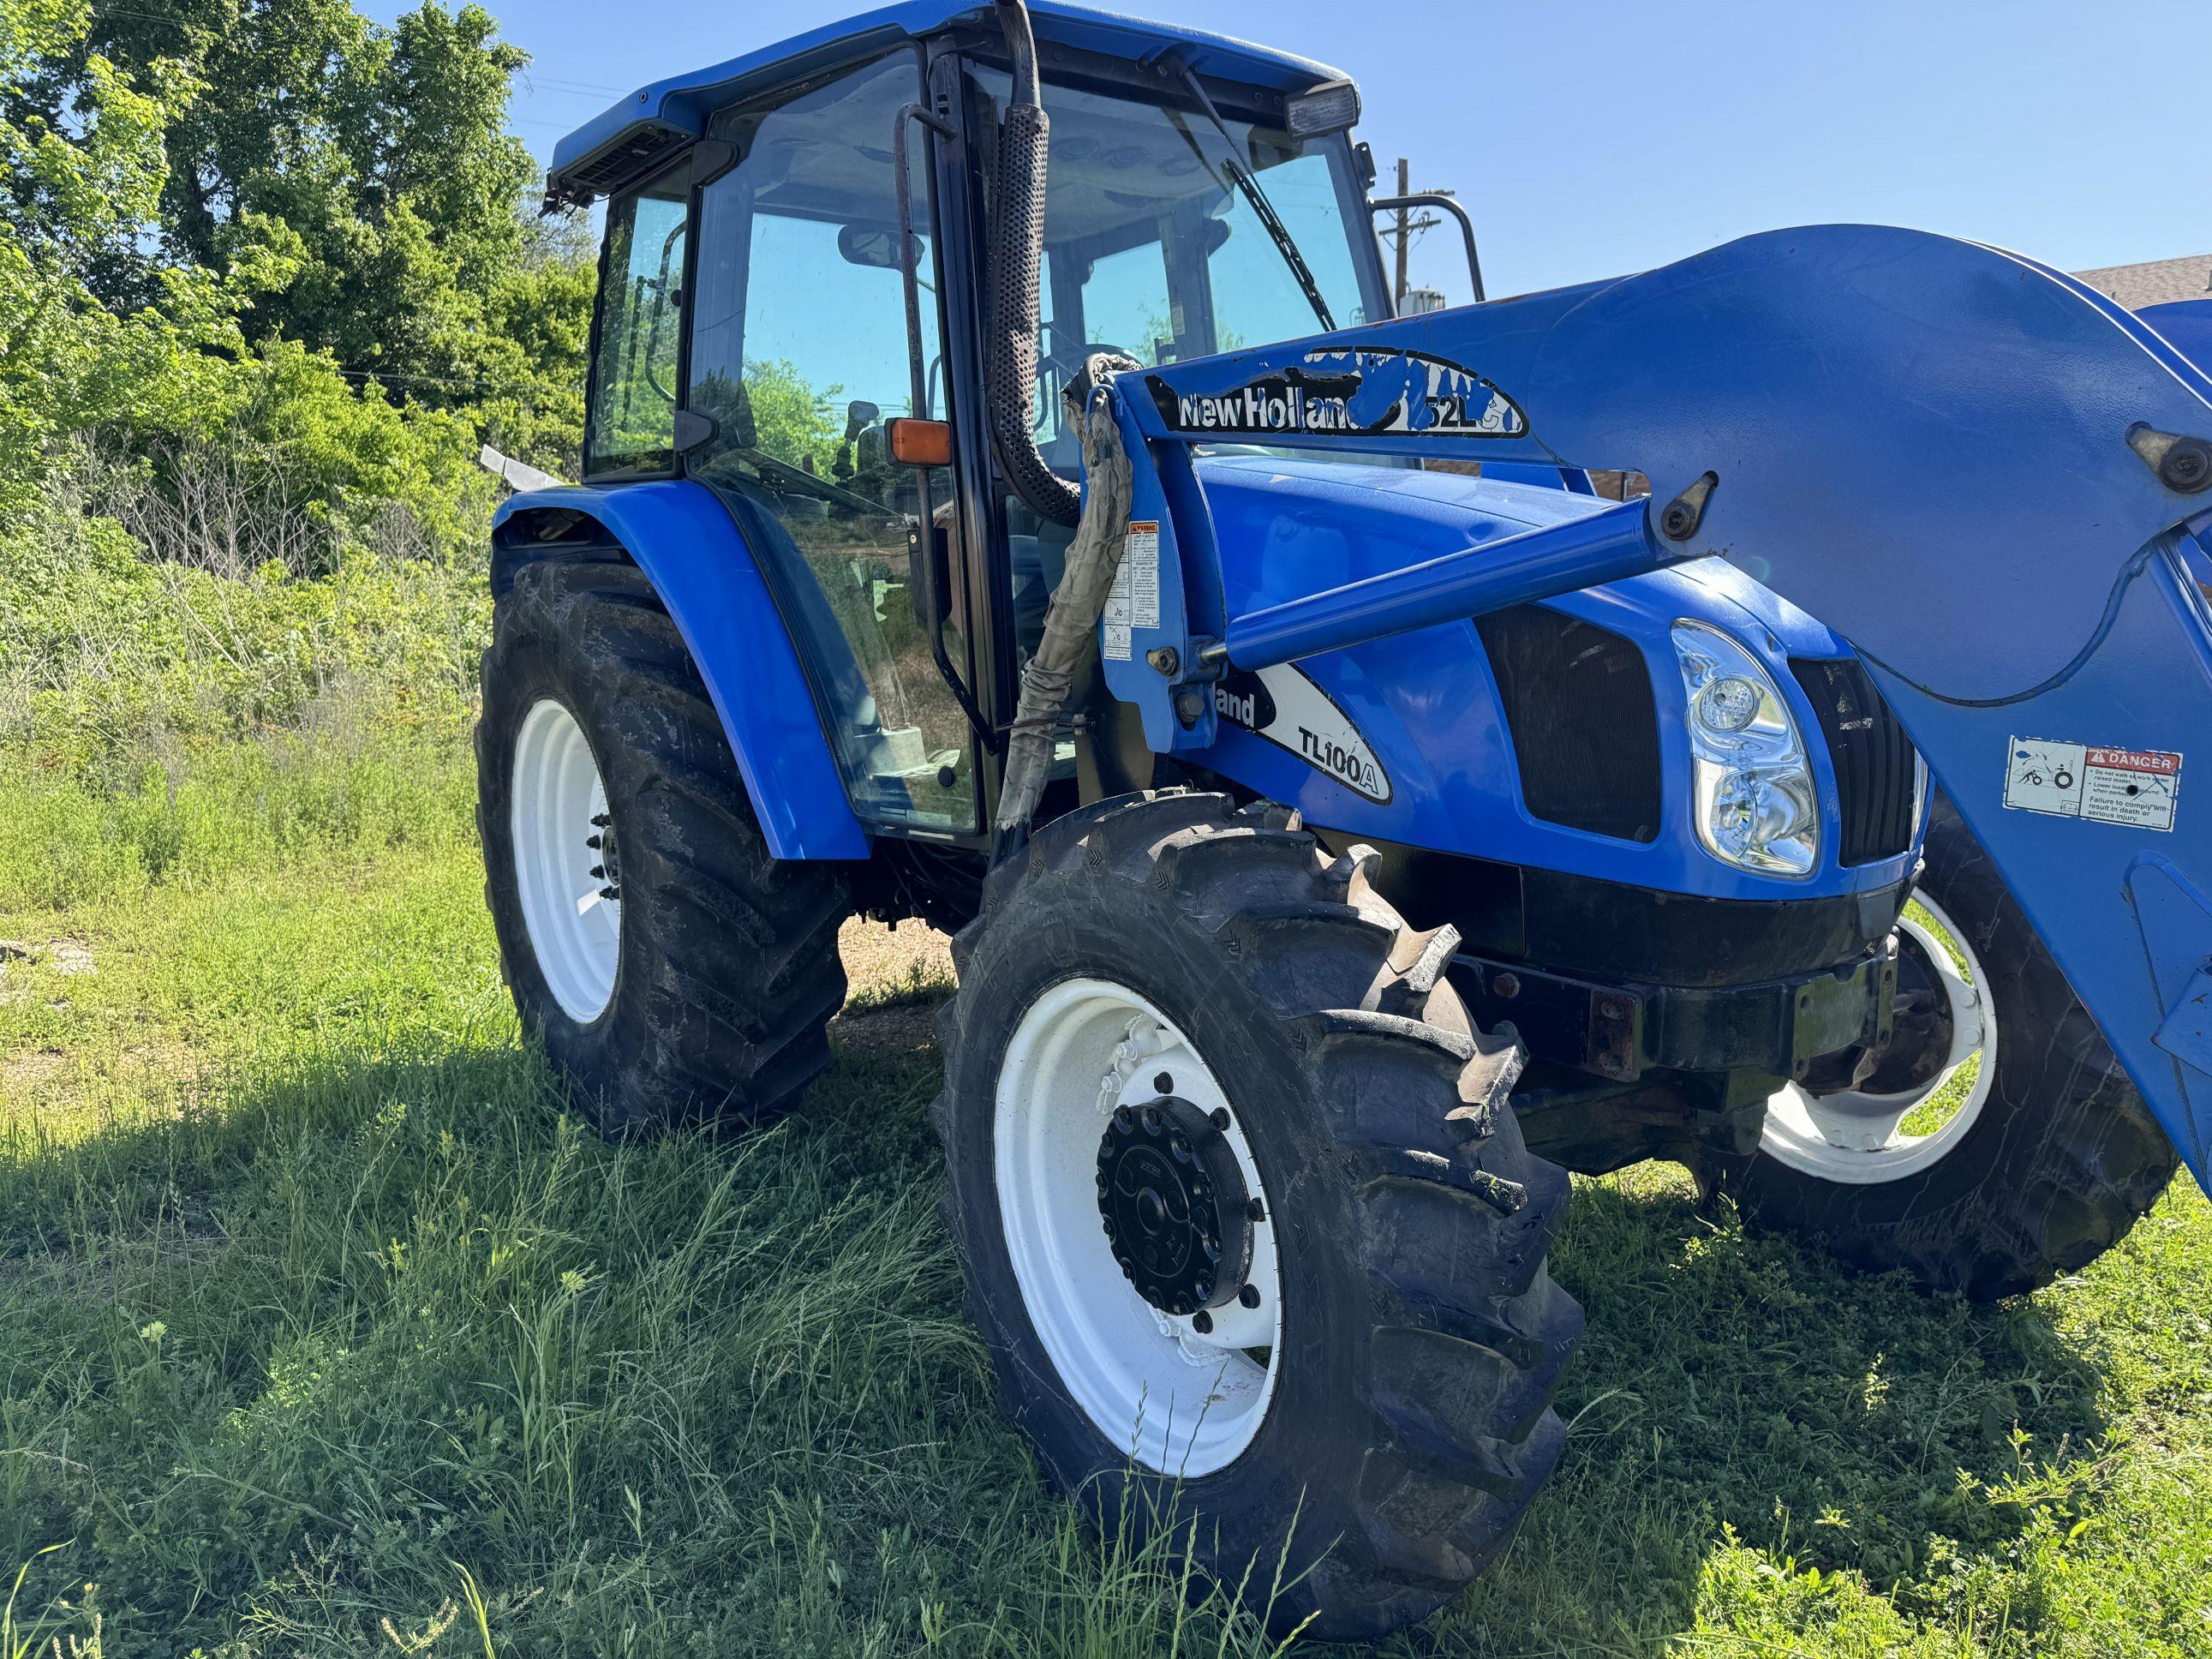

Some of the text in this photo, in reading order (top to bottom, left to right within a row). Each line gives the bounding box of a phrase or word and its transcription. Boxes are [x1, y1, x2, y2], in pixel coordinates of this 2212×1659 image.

[1178, 392, 1241, 427] New
[1298, 725, 1379, 795] TL100A
[2108, 753, 2172, 770] DANGER
[2089, 796, 2114, 805] Failure
[2125, 801, 2152, 811] comply
[2088, 809, 2138, 823] serious injury.
